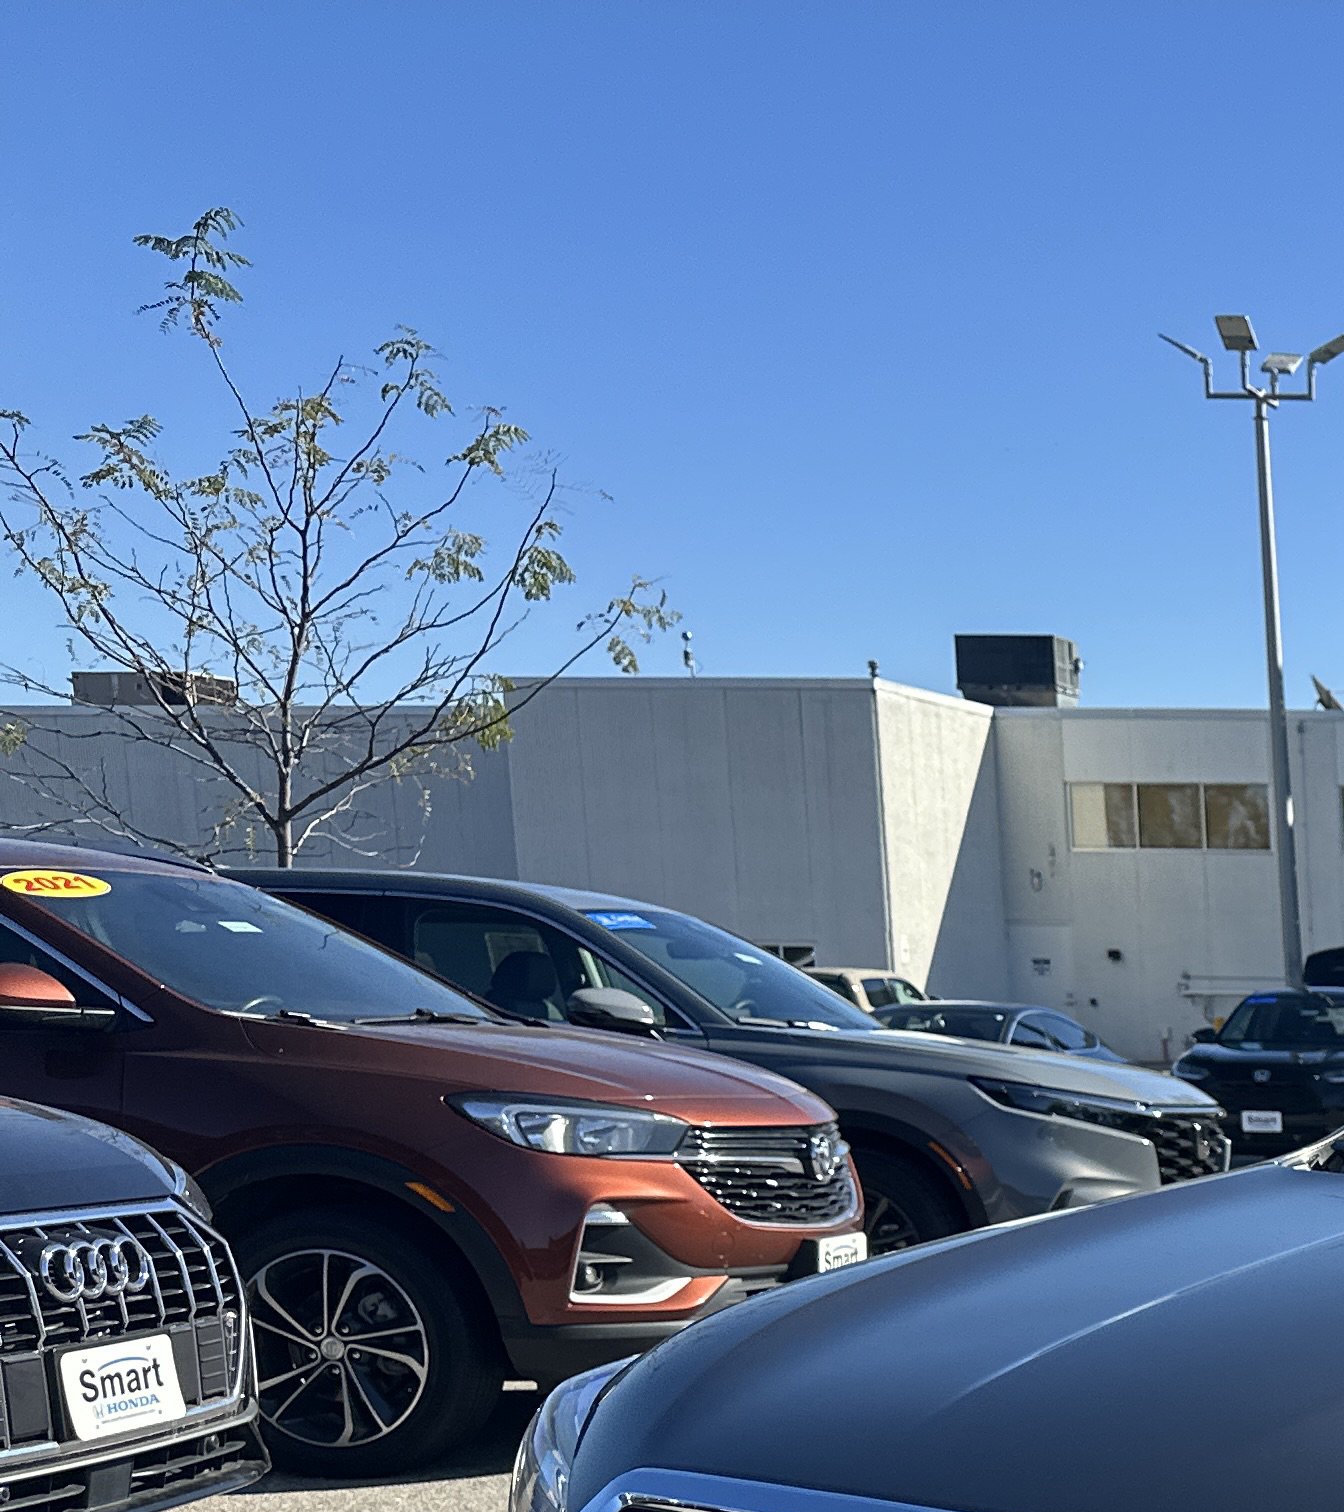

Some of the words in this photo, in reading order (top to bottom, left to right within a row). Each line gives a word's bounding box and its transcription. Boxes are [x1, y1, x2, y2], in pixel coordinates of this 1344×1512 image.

[12, 876, 97, 892] 2021
[79, 1357, 164, 1403] Smart
[107, 1393, 161, 1415] HONDA
